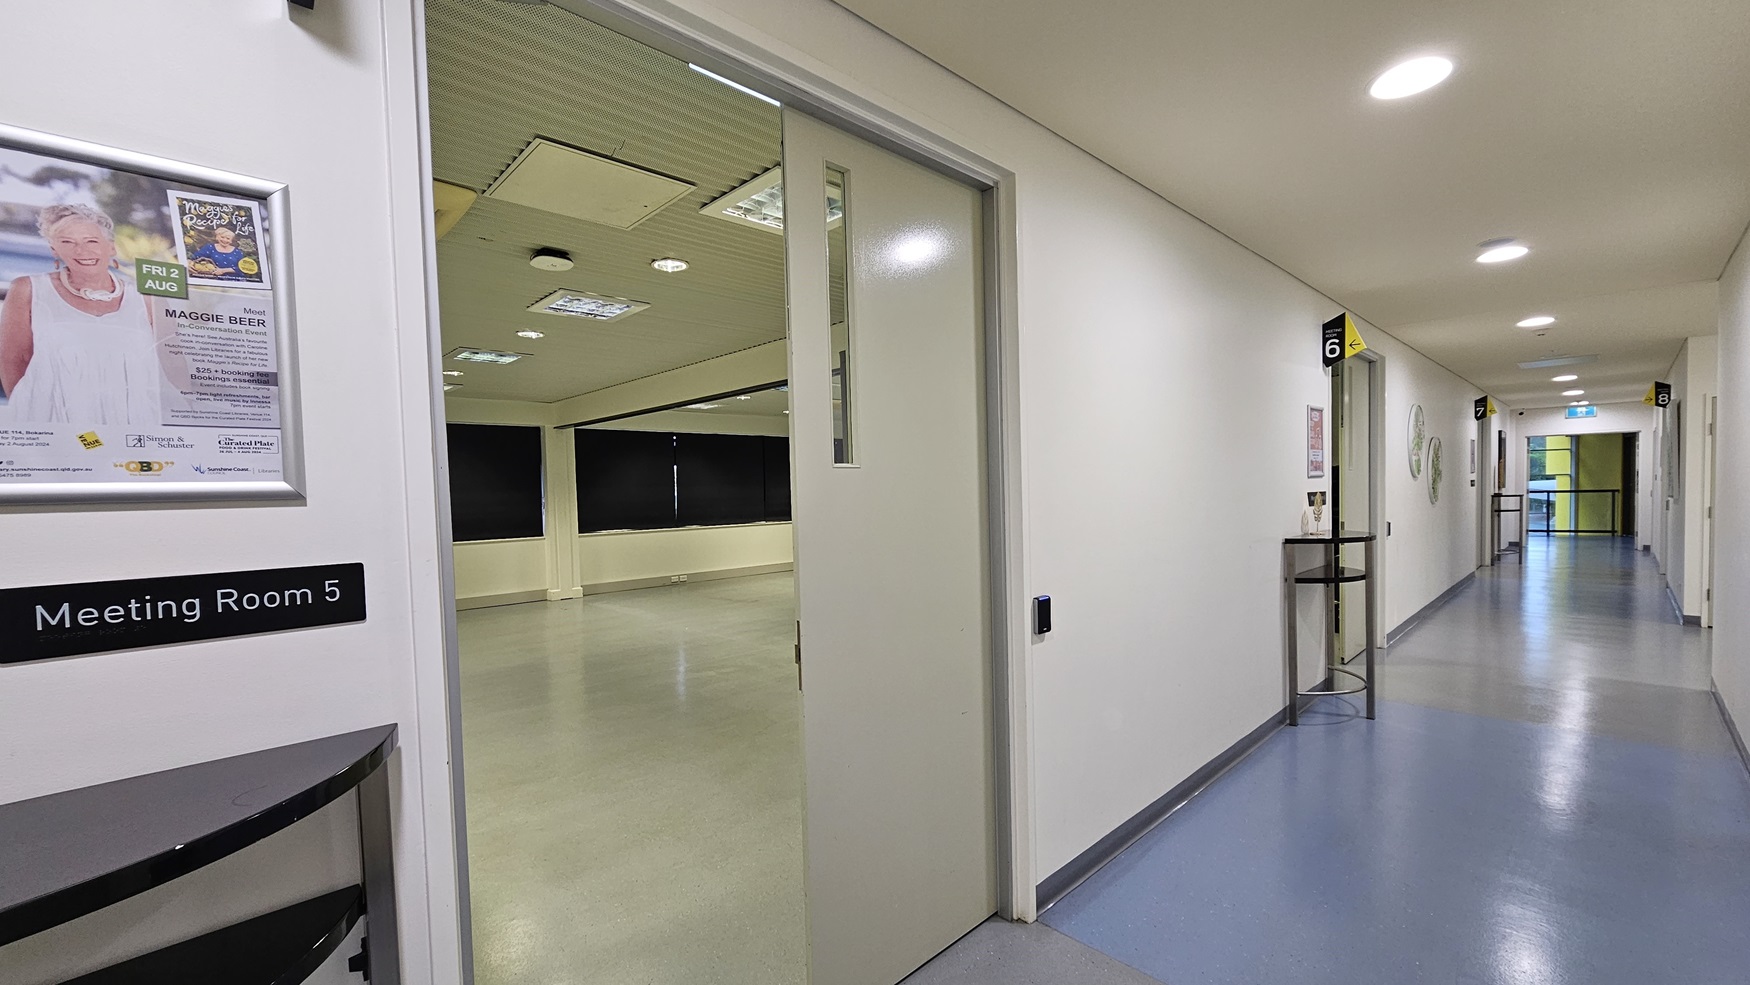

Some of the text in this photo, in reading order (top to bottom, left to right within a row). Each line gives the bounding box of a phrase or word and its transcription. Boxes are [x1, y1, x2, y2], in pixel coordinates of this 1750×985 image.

[183, 201, 233, 218] Maggie's
[183, 212, 247, 230] Recipe for
[236, 222, 254, 235] Life
[142, 264, 166, 276] FRI
[170, 268, 179, 278] 2
[145, 280, 178, 292] AUG
[165, 309, 266, 327] MAGGIE BEER
[244, 308, 266, 316] Meet
[177, 322, 243, 334] In-Conversation
[1325, 339, 1340, 358] 6
[191, 374, 230, 382] Bookings
[221, 369, 254, 378] booking
[1658, 394, 1668, 404] 8
[1476, 407, 1484, 417] 7
[35, 580, 340, 632] Meeting Room 5
